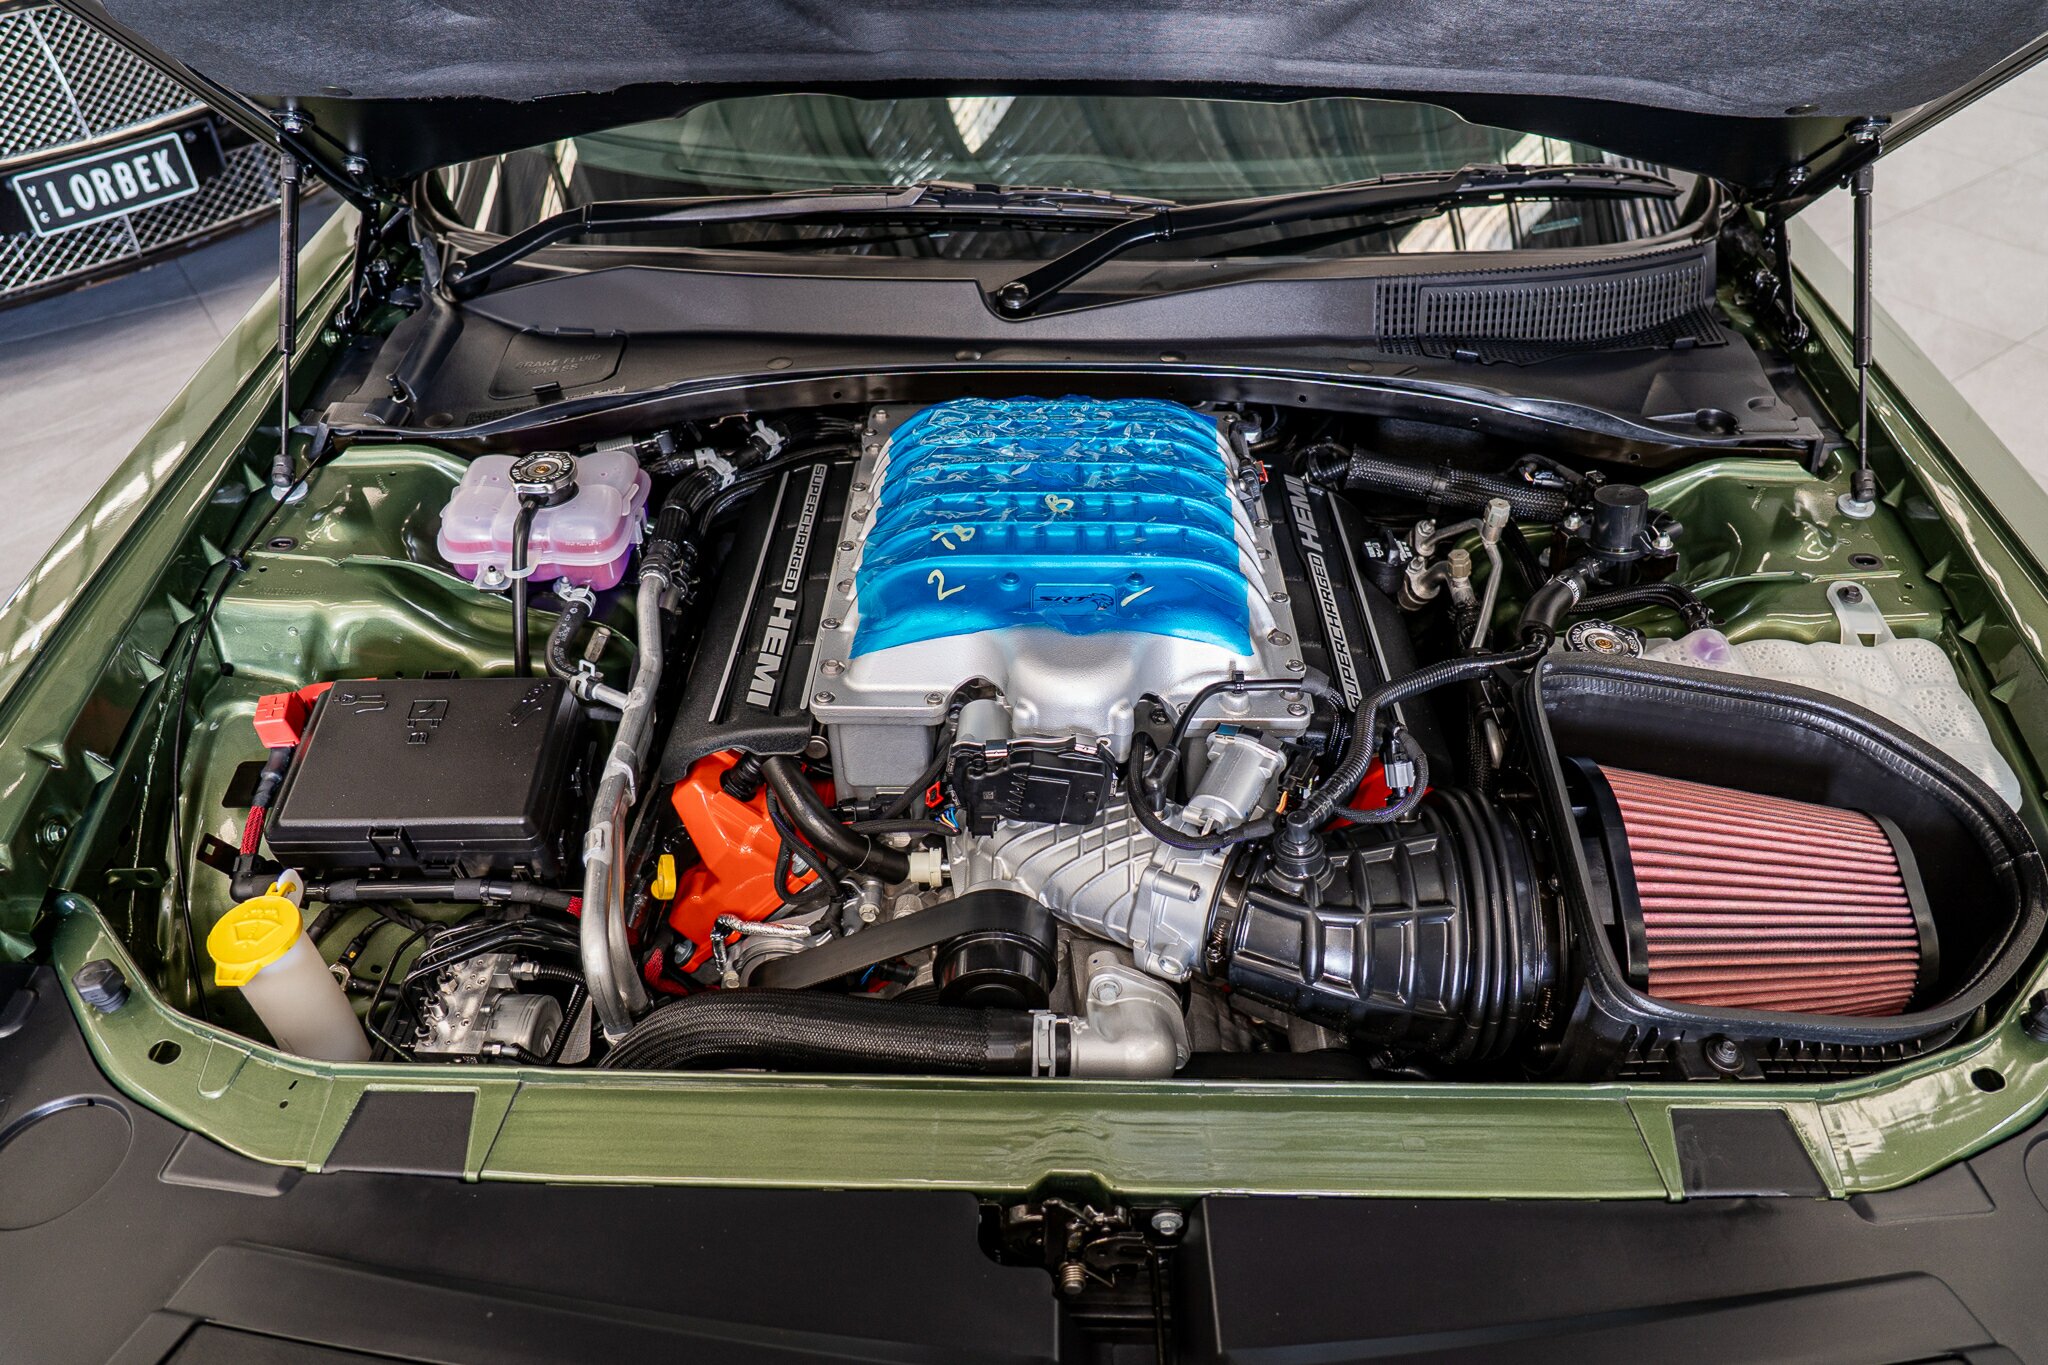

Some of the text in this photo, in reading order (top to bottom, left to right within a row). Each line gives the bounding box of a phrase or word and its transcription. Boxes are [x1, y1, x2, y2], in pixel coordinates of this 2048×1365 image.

[45, 149, 181, 218] LORBEK
[26, 185, 50, 223] VIC
[515, 359, 559, 370] BRAKE
[746, 464, 826, 707] SUPERCHARGED HEMI
[928, 569, 966, 601] 2
[1039, 595, 1092, 603] SRT
[1283, 473, 1362, 712] SUPERCHARGED HEMI
